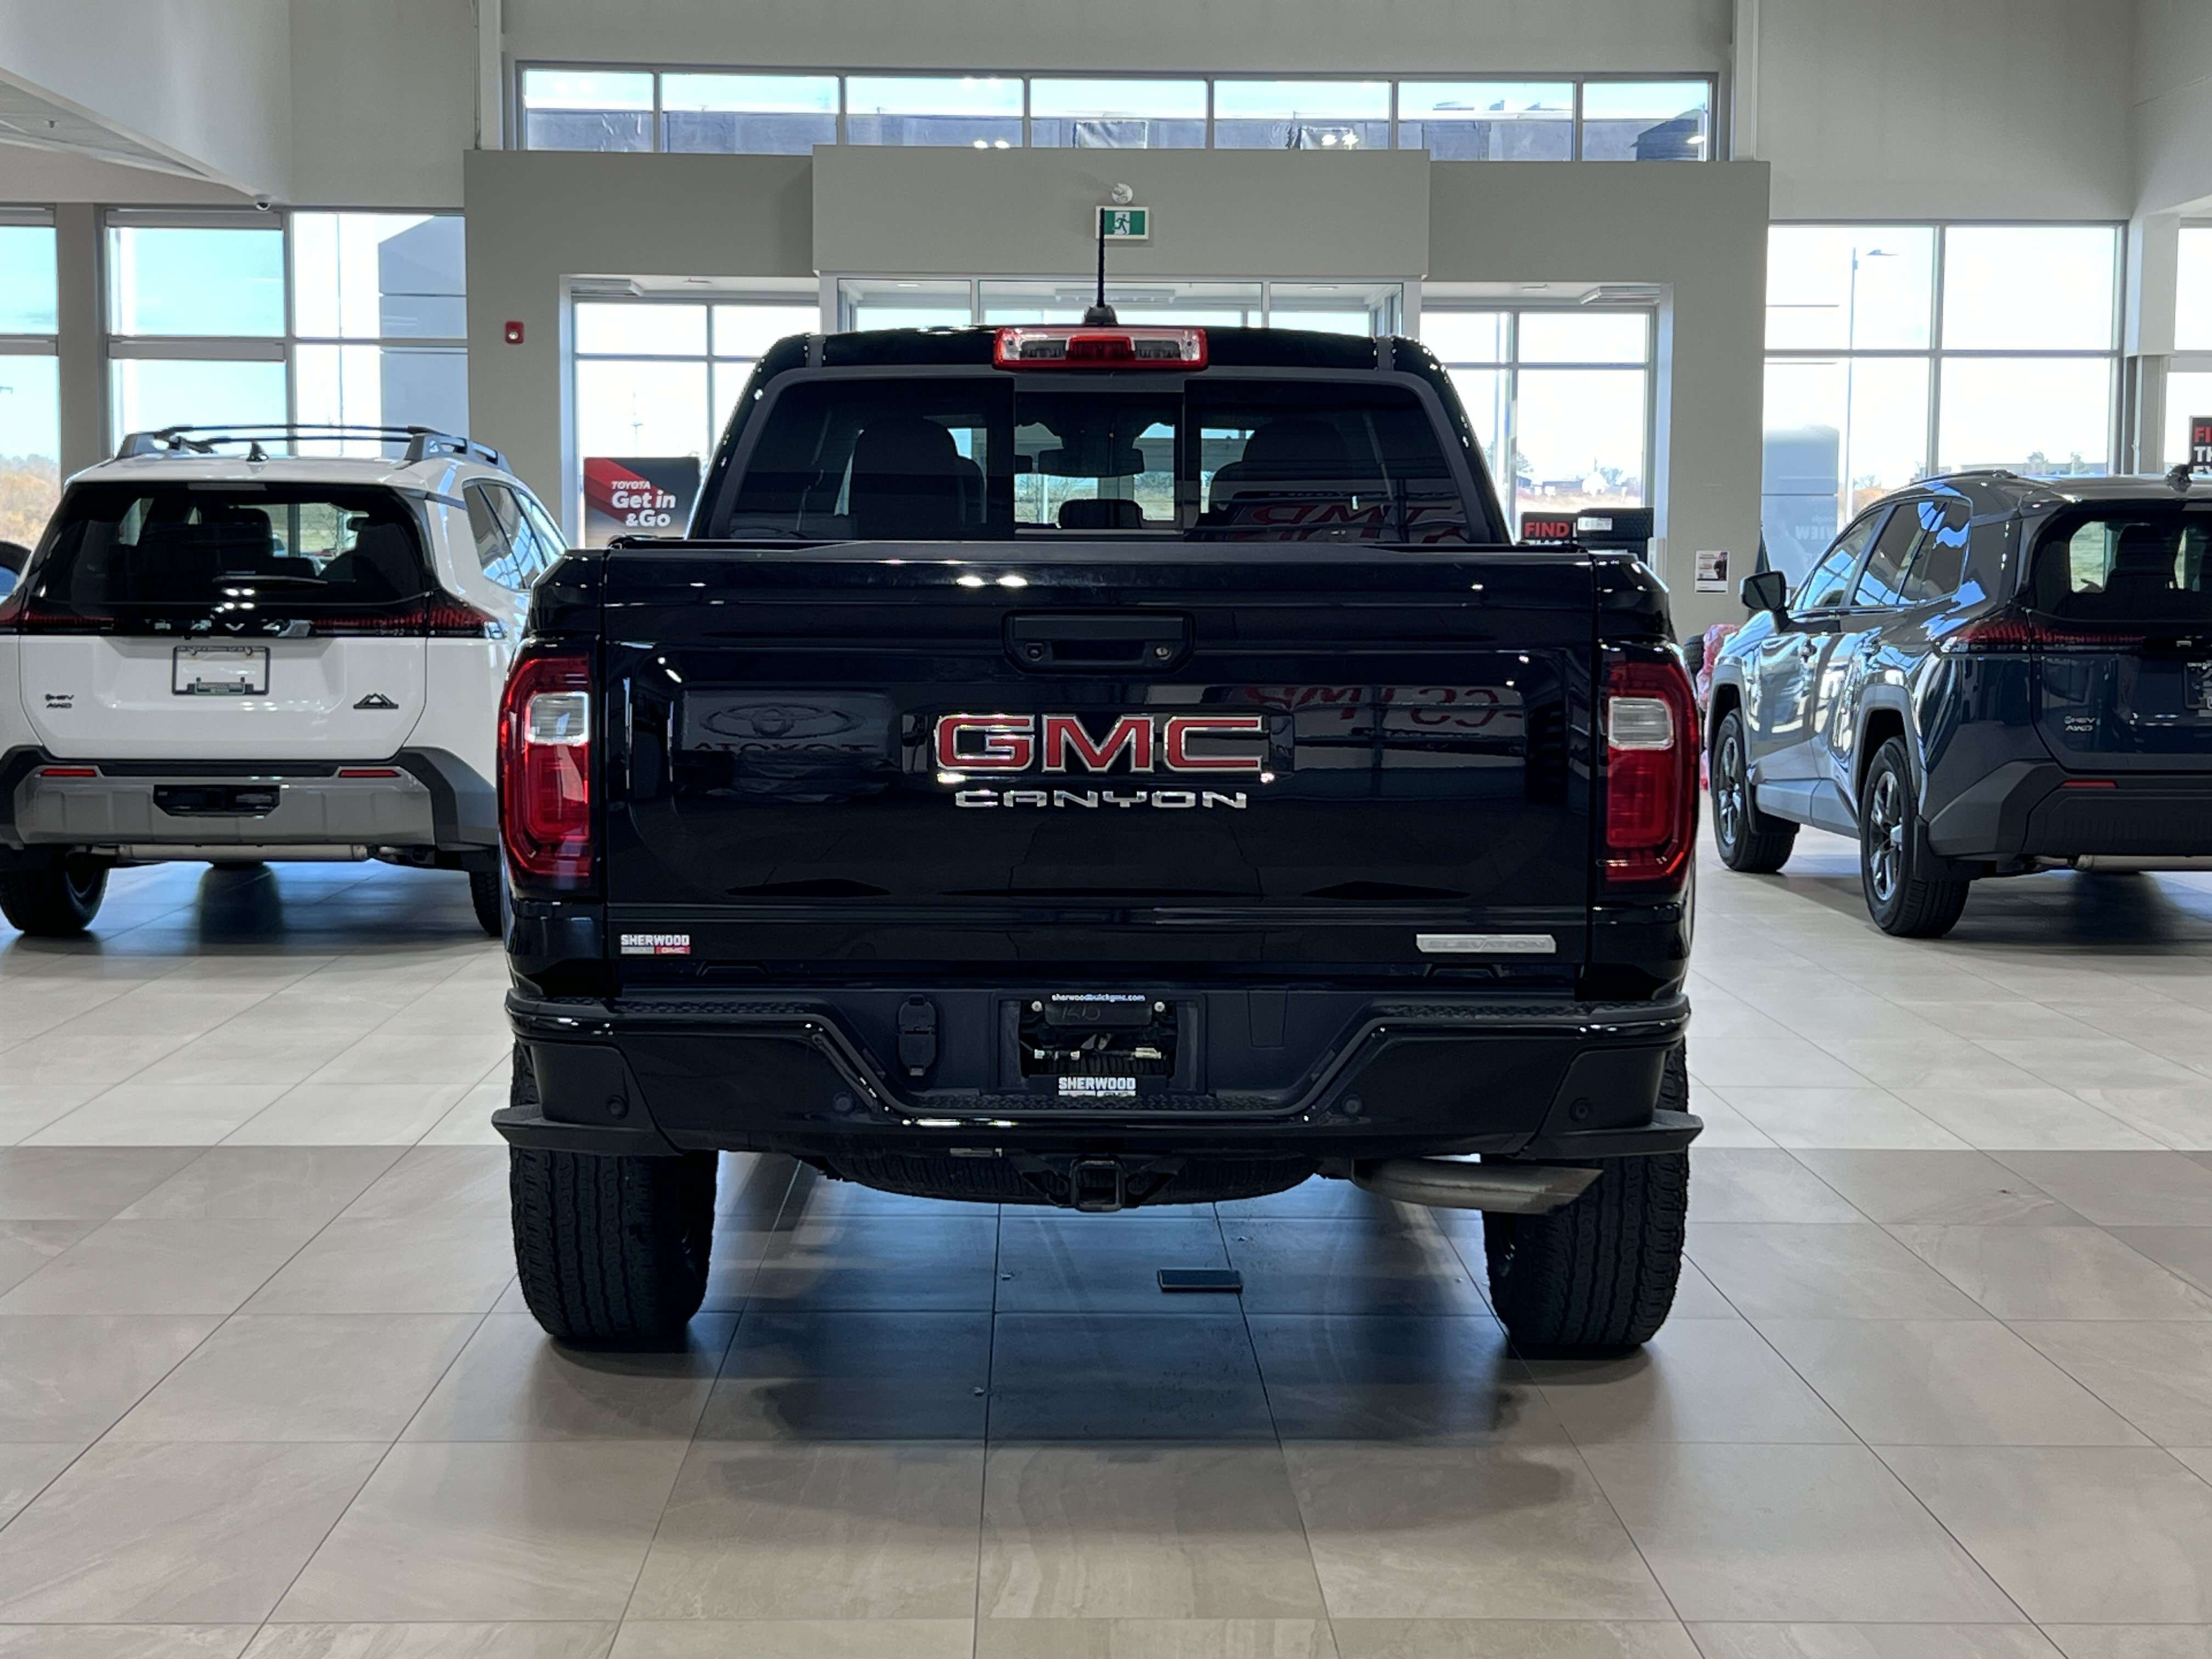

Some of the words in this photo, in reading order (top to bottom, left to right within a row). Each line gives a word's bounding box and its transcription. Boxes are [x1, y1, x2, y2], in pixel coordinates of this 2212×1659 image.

[611, 481, 651, 489] TOYOTA
[612, 491, 653, 509] Get
[656, 490, 676, 509] in
[625, 510, 671, 527] &Go
[1525, 522, 1570, 538] FIND
[934, 714, 1262, 772] GMC
[955, 789, 1247, 809] CANYON
[621, 934, 690, 946] SHERWOOD
[1058, 1077, 1136, 1090] SHERWOOD
